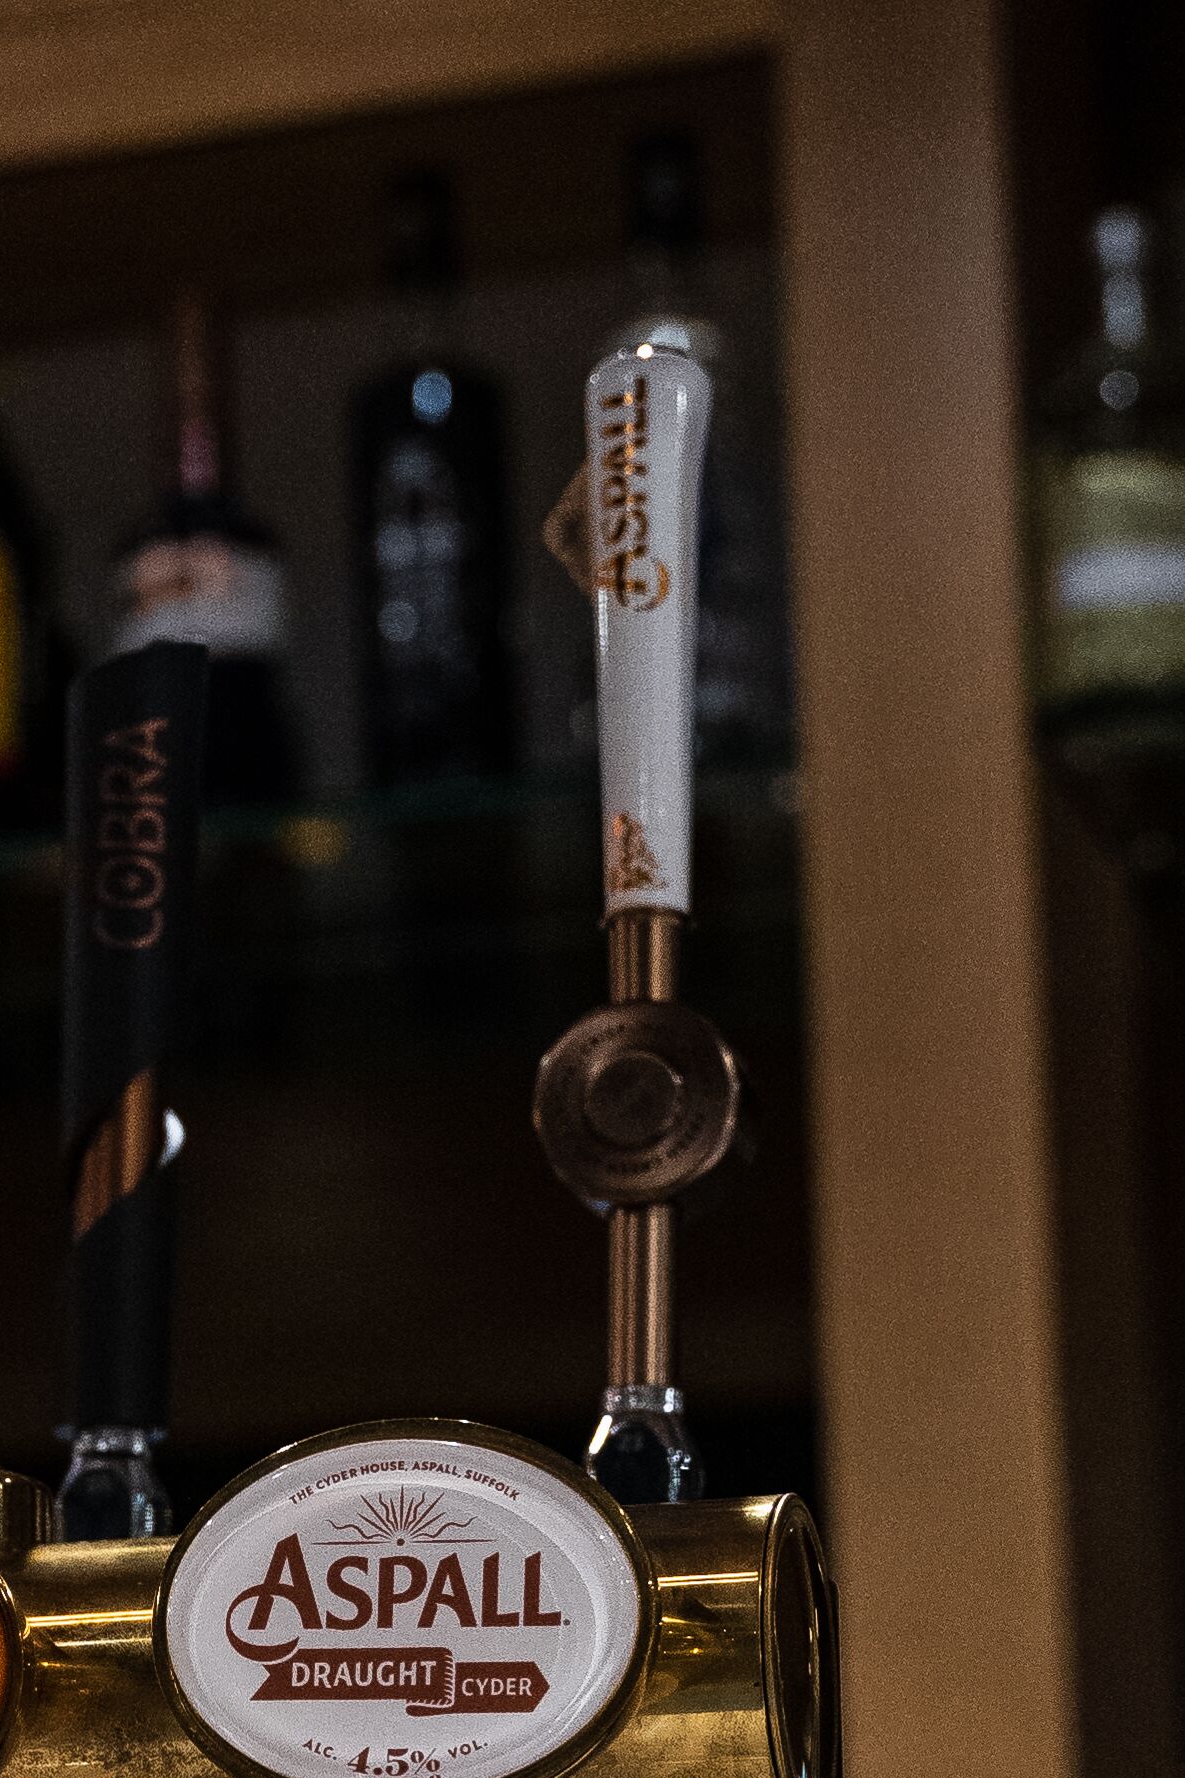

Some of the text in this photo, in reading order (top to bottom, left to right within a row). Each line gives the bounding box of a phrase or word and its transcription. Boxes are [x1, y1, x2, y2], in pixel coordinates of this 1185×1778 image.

[597, 377, 672, 612] ASPALL
[96, 718, 170, 950] COBRA
[289, 1460, 520, 1505] THE CYDER HOUSE, ASPALL, SUFFOLK
[225, 1533, 562, 1662] ASPALL
[291, 1659, 532, 1698] DRAUGHT CYDER
[302, 1738, 489, 1777] ALC. 4.5% VOL.
